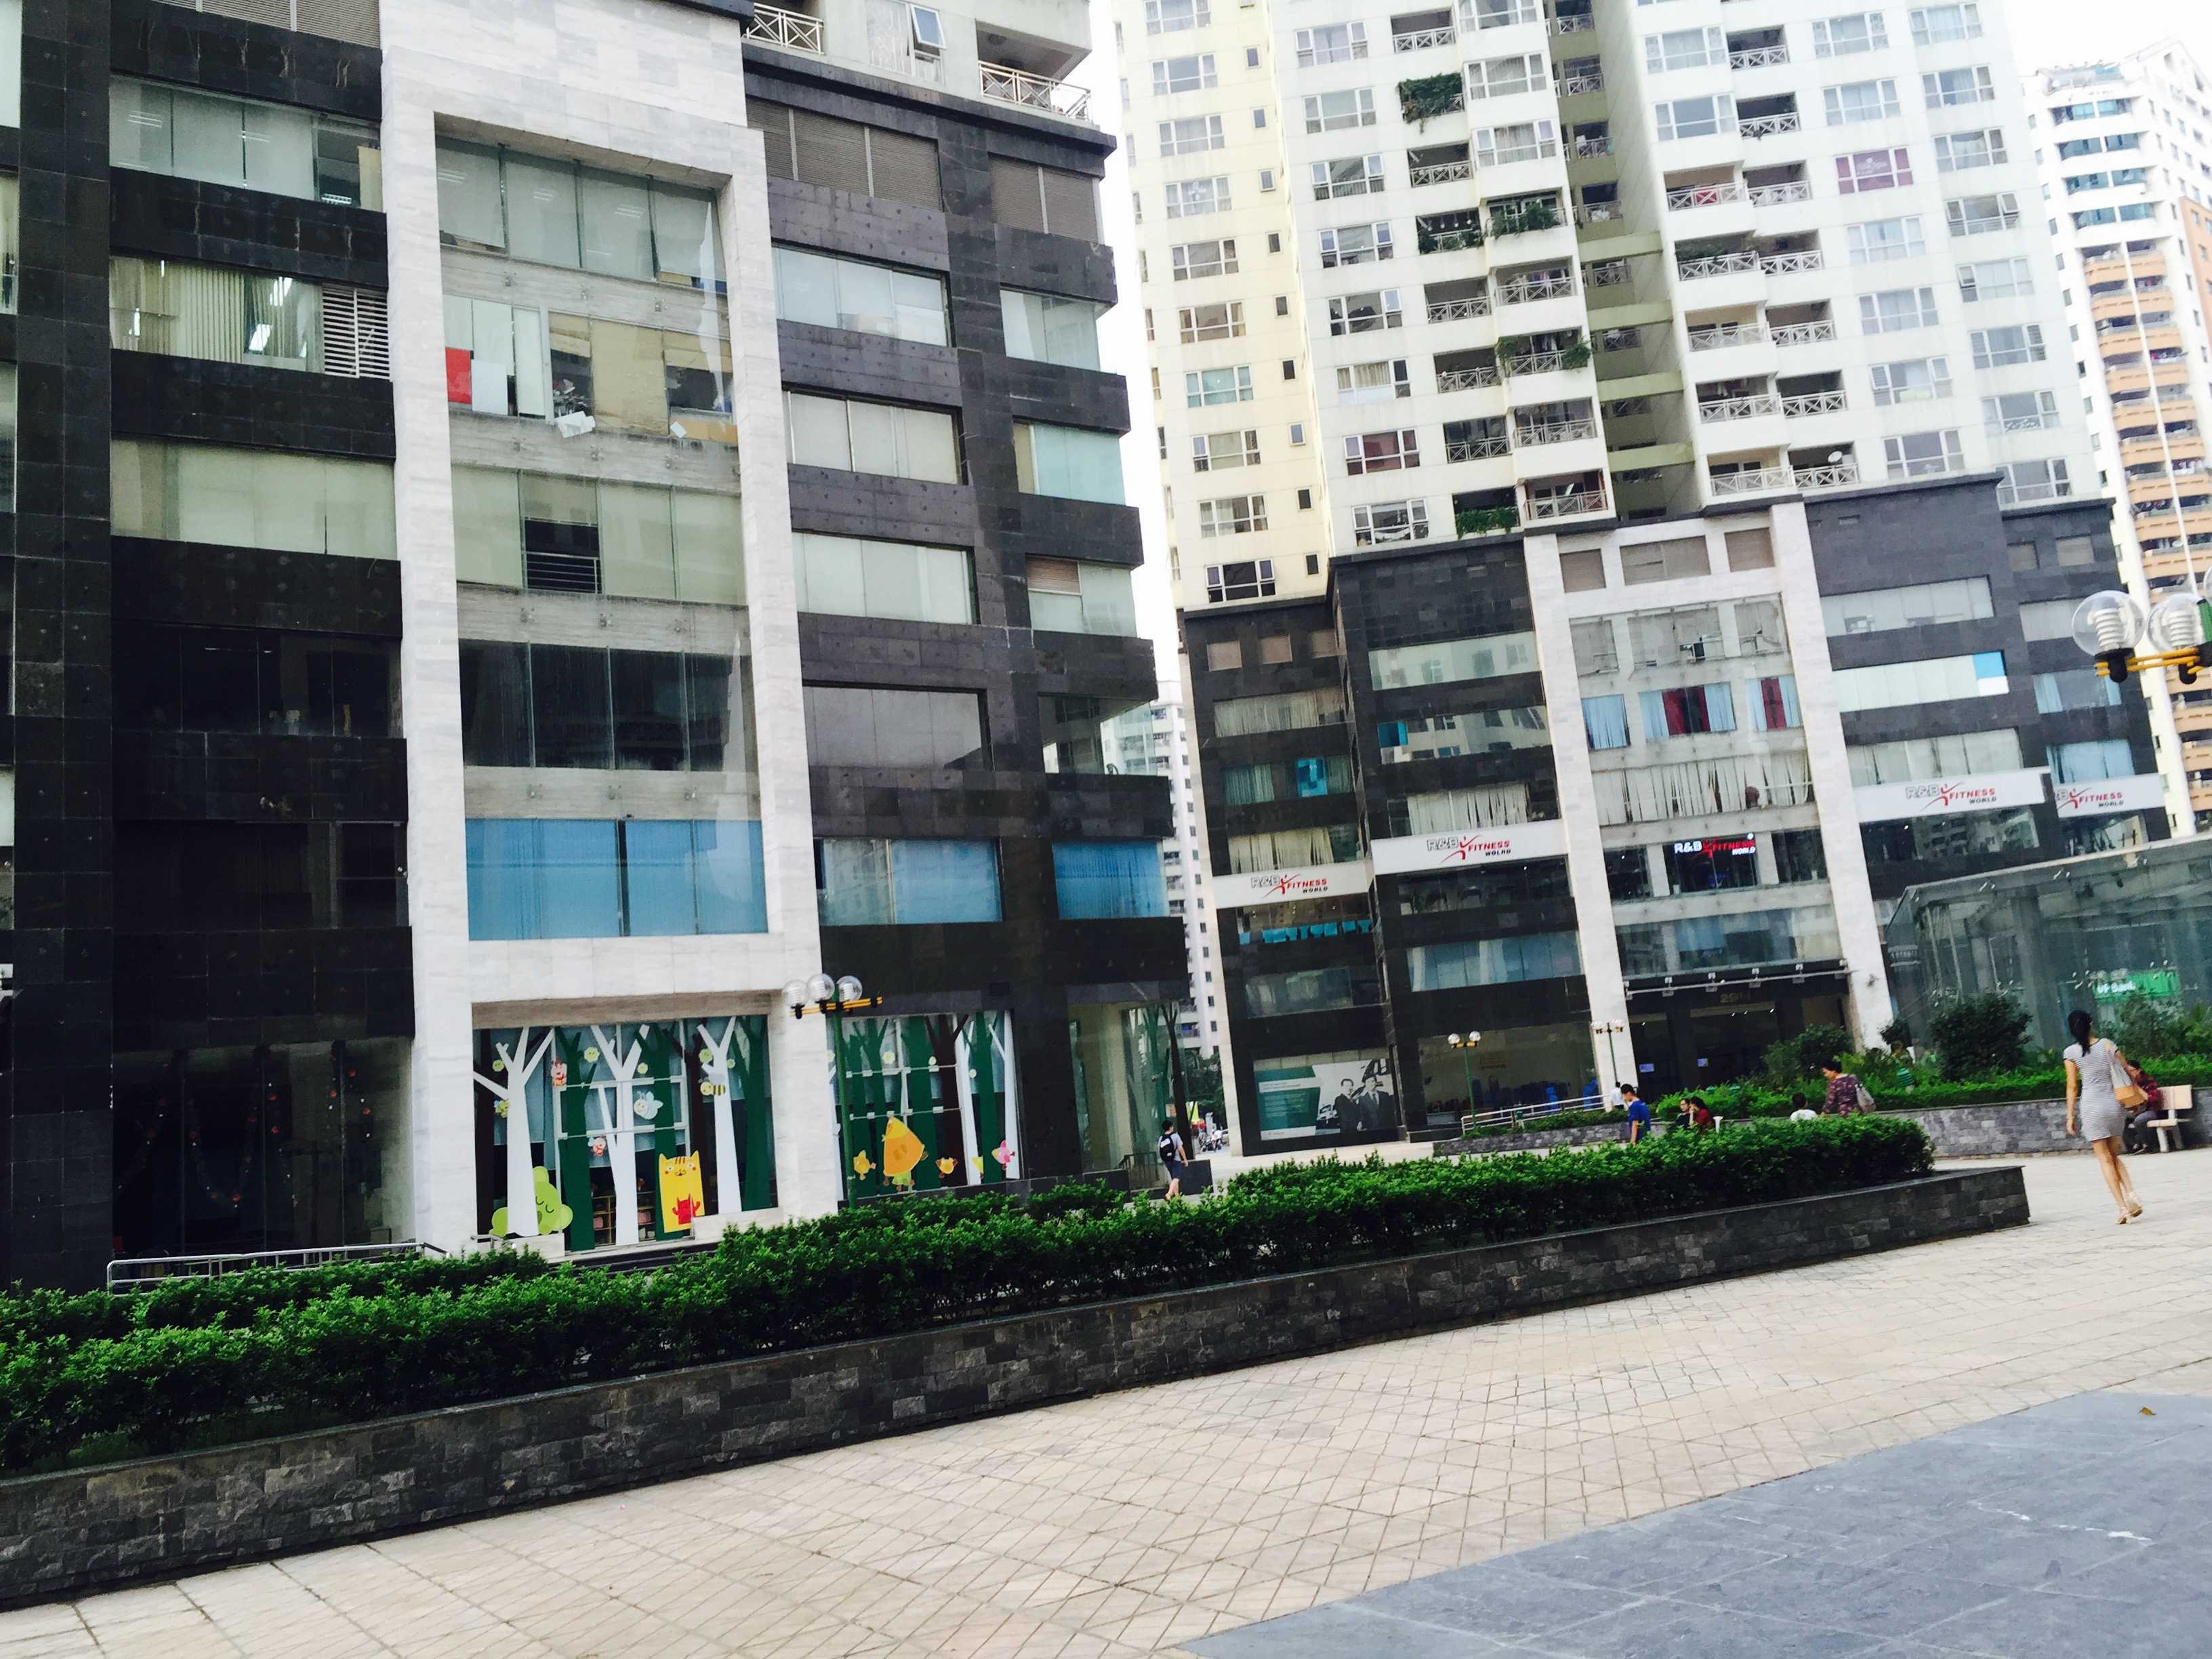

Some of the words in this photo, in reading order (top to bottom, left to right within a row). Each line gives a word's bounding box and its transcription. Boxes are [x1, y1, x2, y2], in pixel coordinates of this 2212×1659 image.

[1906, 784, 1940, 798] R&B
[1949, 787, 1996, 800] FITNESS
[2079, 792, 2123, 803] FITNESS
[1427, 837, 1458, 851] R&B
[1468, 840, 1510, 851] FITNESS
[1674, 840, 1702, 854] R&B
[1713, 840, 1755, 851] FITNESS
[1250, 875, 1279, 889] R&B
[1287, 878, 1327, 889] FITNESS
